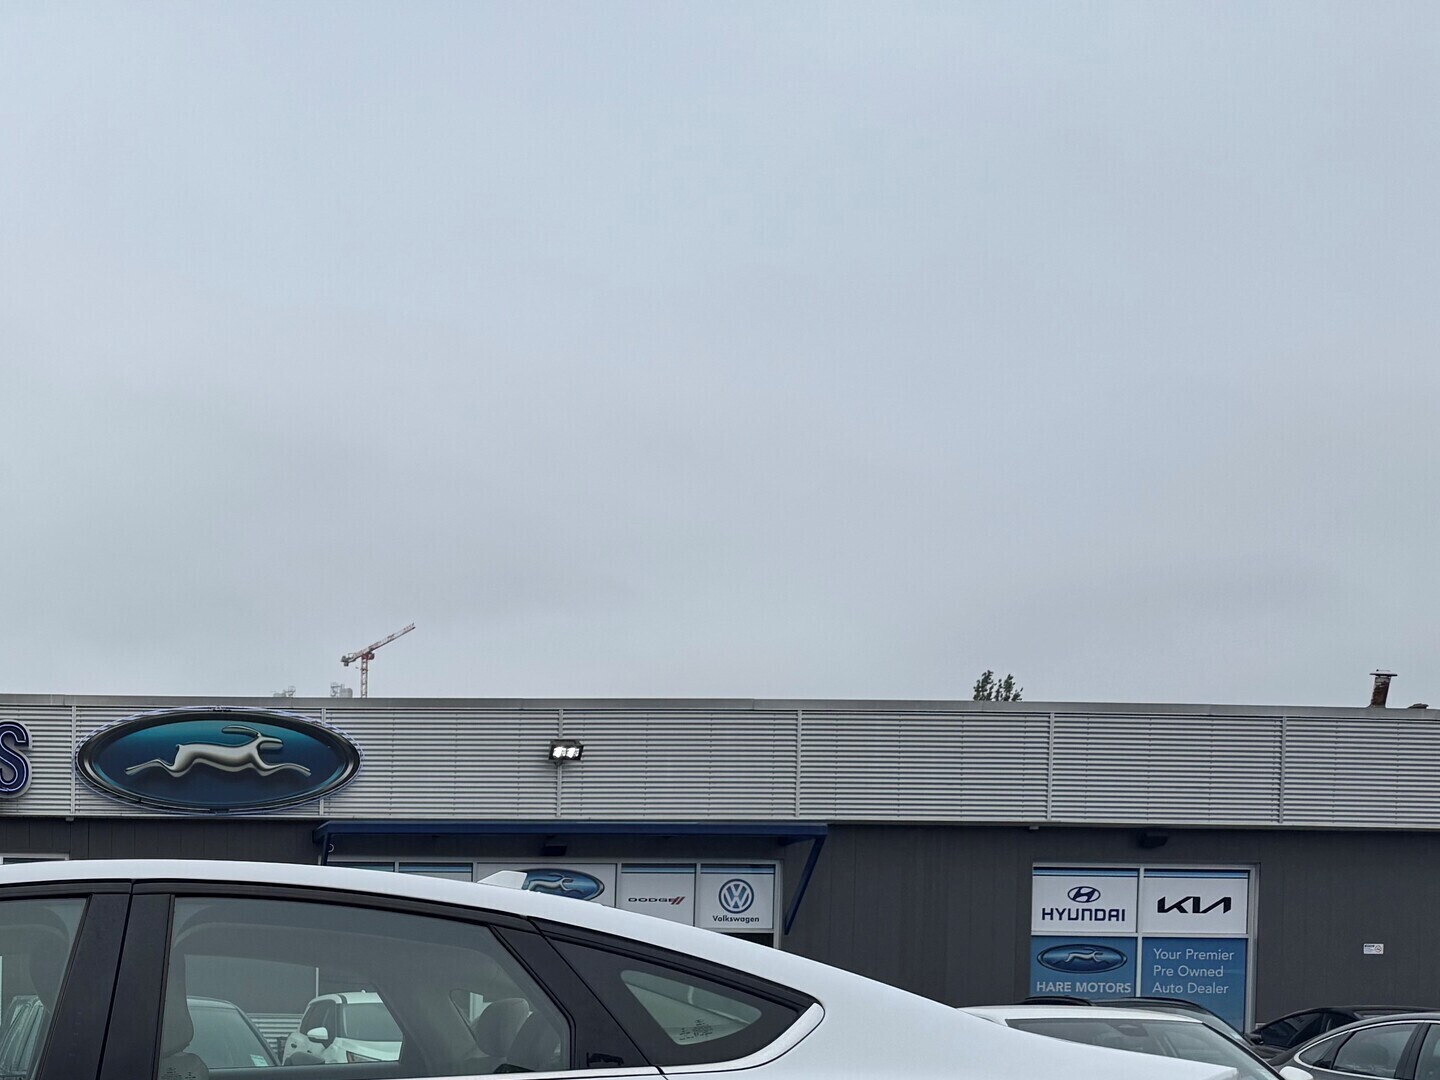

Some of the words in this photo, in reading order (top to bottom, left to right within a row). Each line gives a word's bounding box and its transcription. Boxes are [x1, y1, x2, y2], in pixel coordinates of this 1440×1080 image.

[1157, 896, 1232, 914] KIA
[712, 915, 760, 924] Volkswagen
[1041, 907, 1126, 922] HYUNDAI
[1153, 948, 1182, 961] Your
[1186, 949, 1235, 961] Premier
[1153, 966, 1174, 977] Pre
[1178, 966, 1224, 977] Owned
[1036, 981, 1072, 992] HARE
[1076, 982, 1132, 994] MOTORS
[1152, 982, 1184, 994] Auto
[1188, 982, 1229, 994] Dealer
